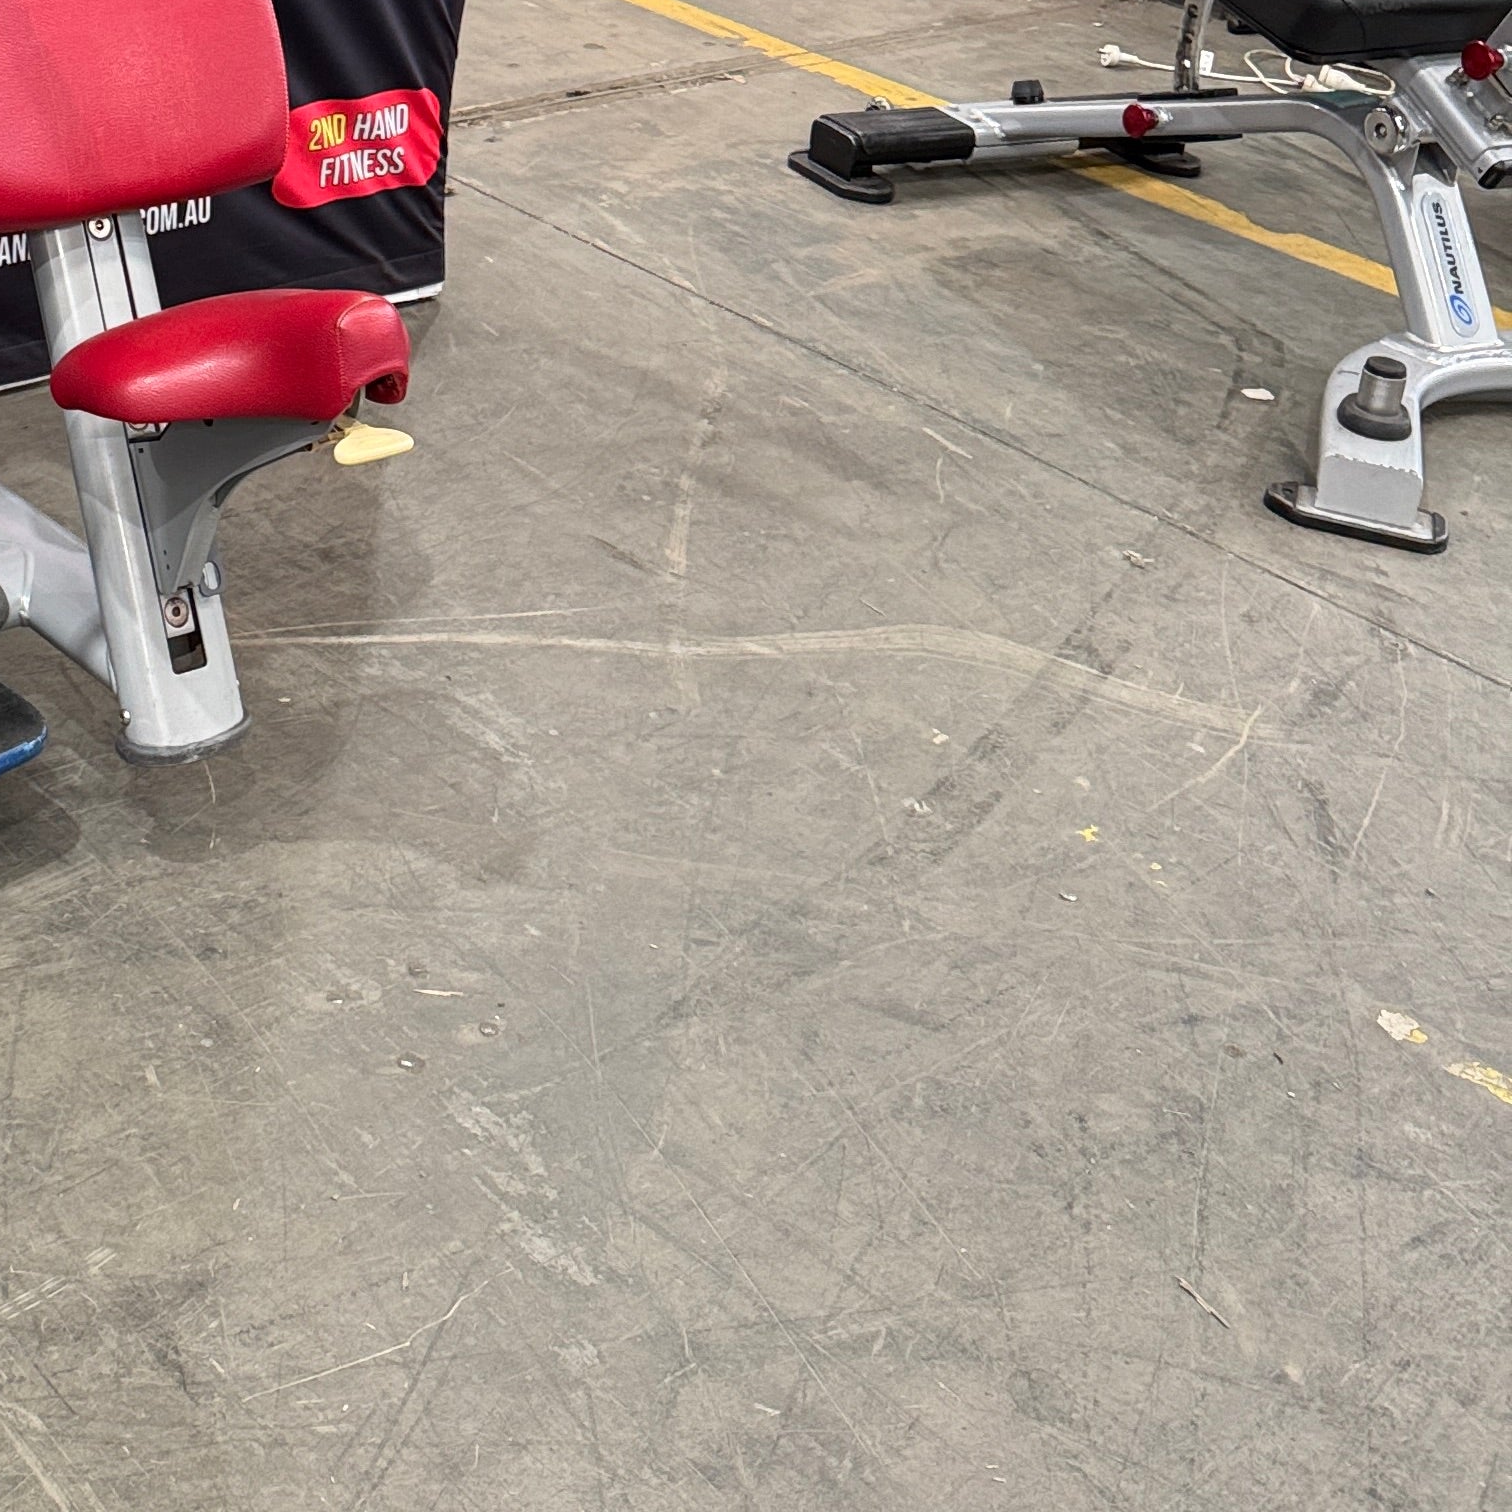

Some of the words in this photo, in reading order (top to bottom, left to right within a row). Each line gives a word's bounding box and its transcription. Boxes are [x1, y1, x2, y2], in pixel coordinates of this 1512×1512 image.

[309, 113, 346, 151] 2ND
[352, 103, 409, 140] HAND
[320, 146, 405, 188] FITNESS
[1431, 201, 1464, 295] NAUTILUS
